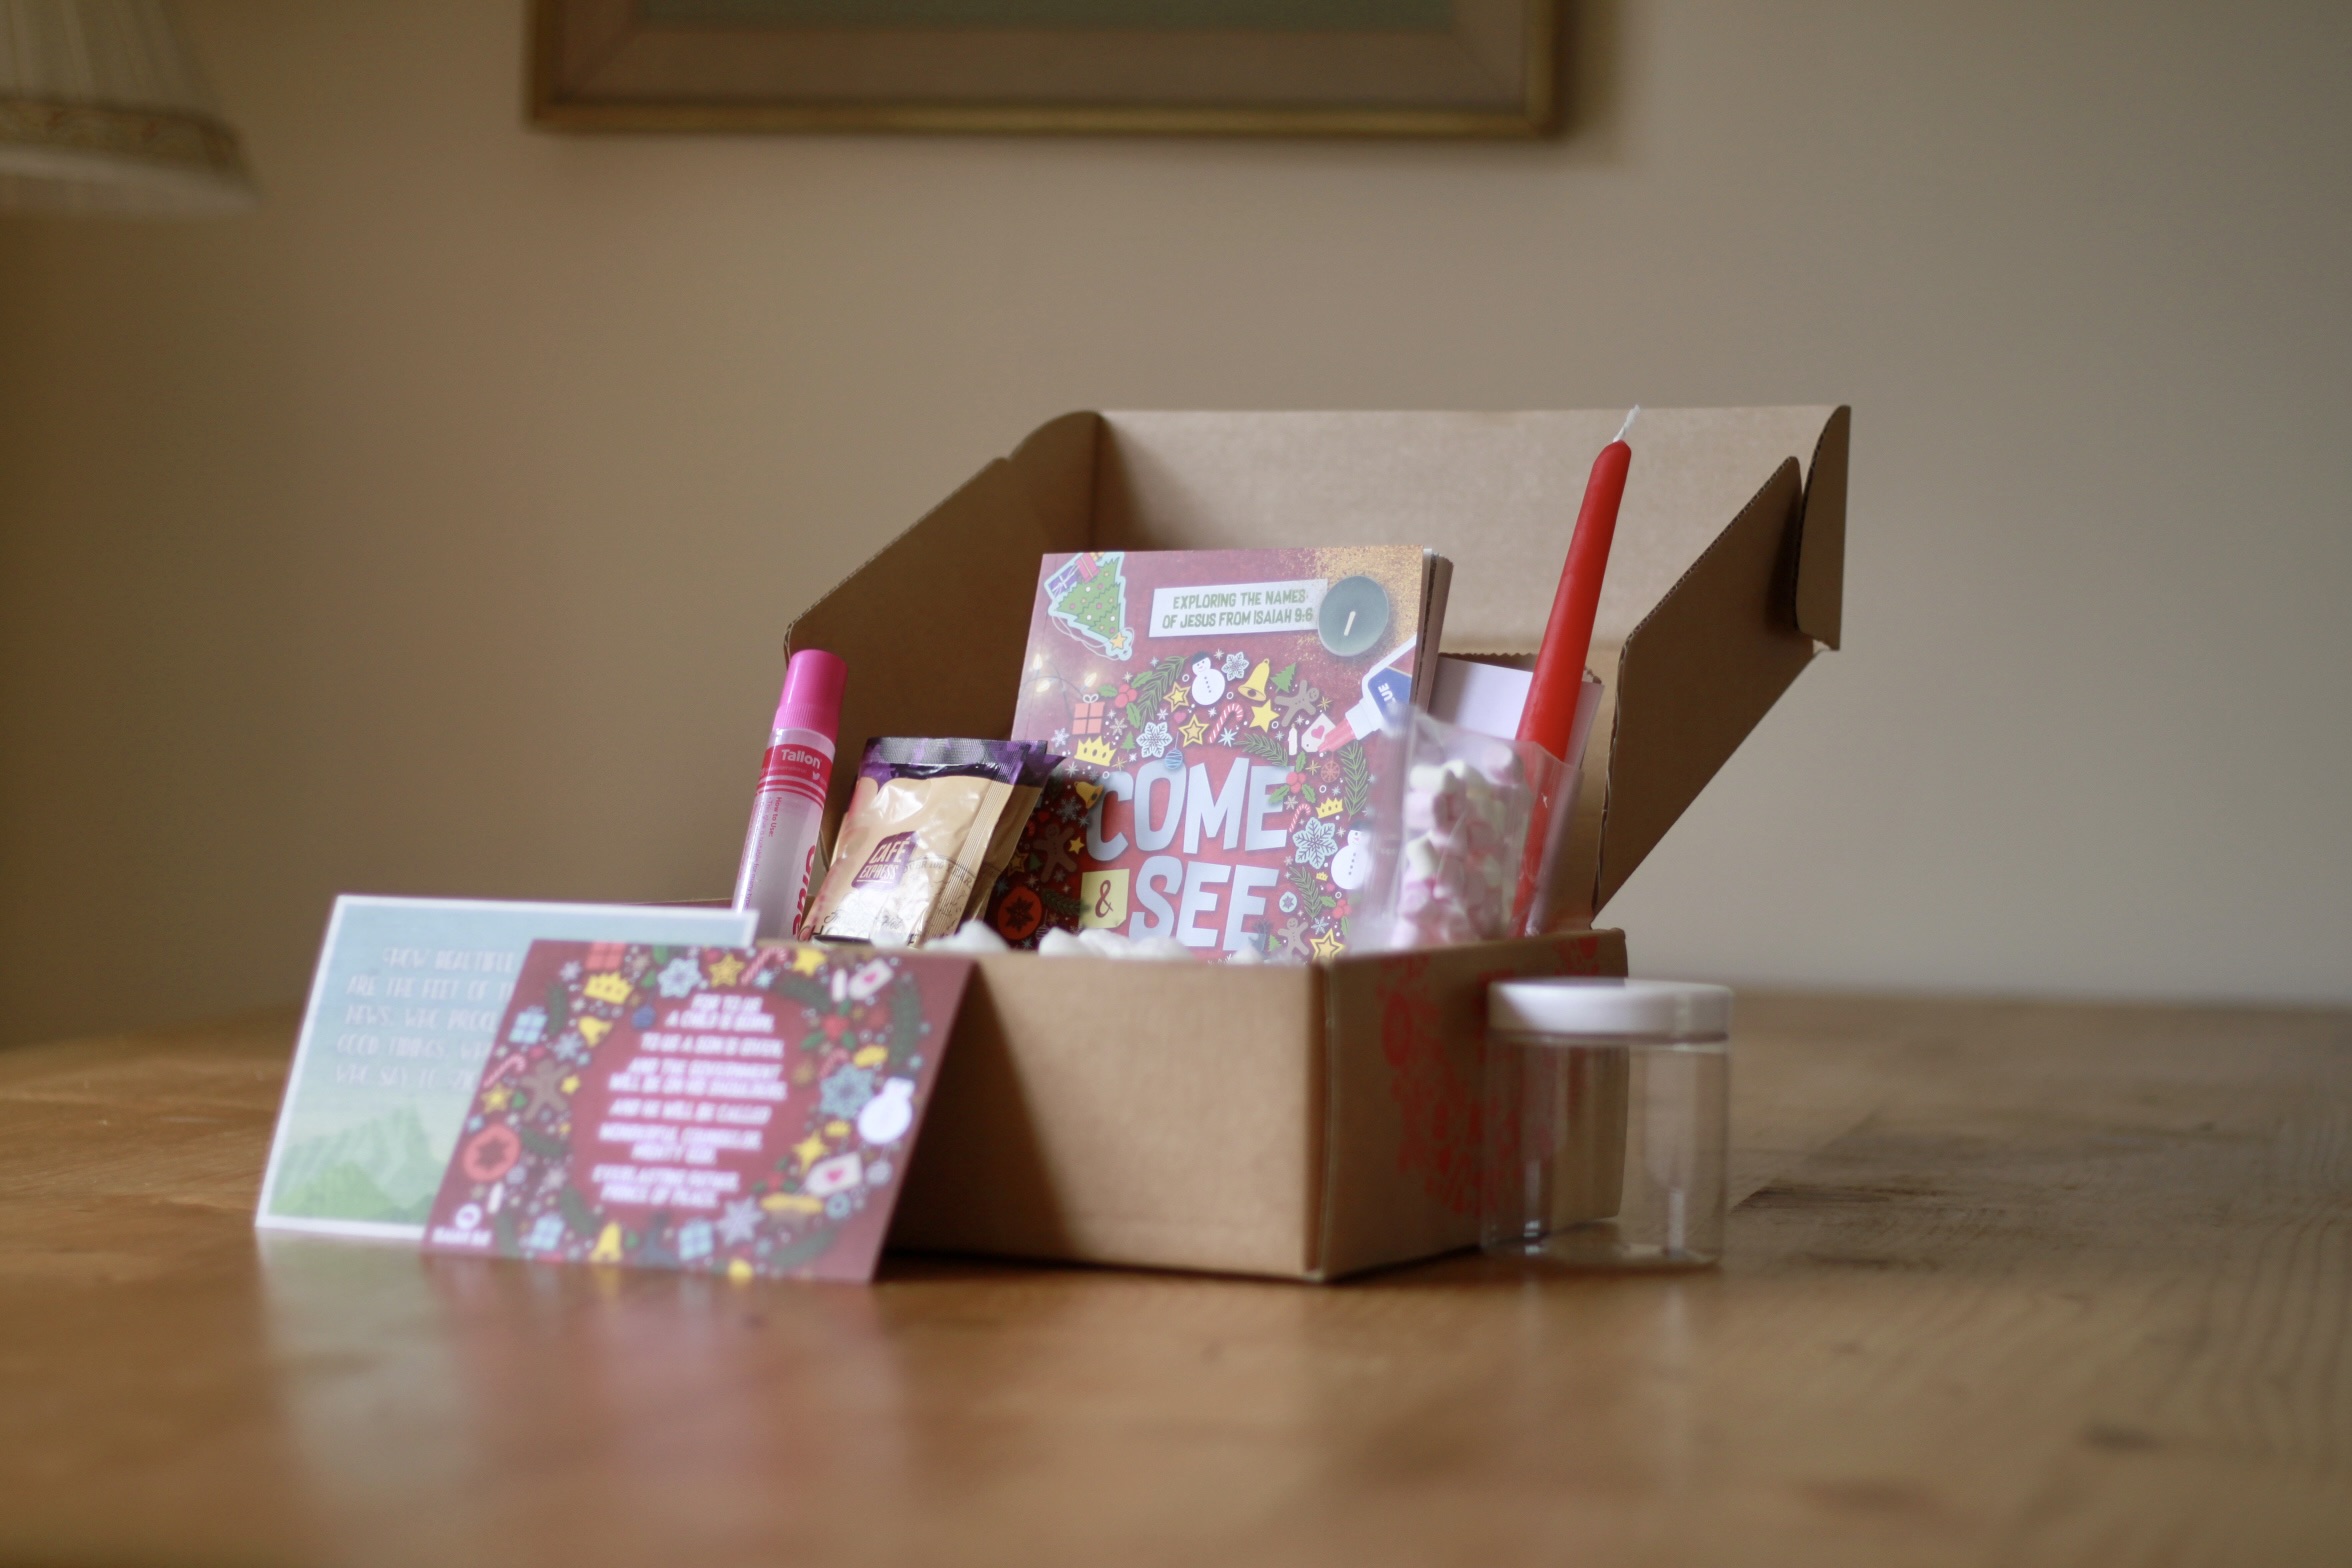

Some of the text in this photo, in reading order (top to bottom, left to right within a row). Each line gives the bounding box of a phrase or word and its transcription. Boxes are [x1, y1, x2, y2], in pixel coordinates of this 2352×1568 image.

[1173, 589, 1306, 610] EXPLORING THE NAMES
[1162, 607, 1314, 629] OF JESUS FROM ISAIAH 9:6
[782, 749, 821, 769] Tallon
[1086, 757, 1294, 861] COME
[869, 837, 911, 864] CAFÉ
[860, 864, 899, 880] EXPRESS
[1095, 855, 1279, 951] & SEE
